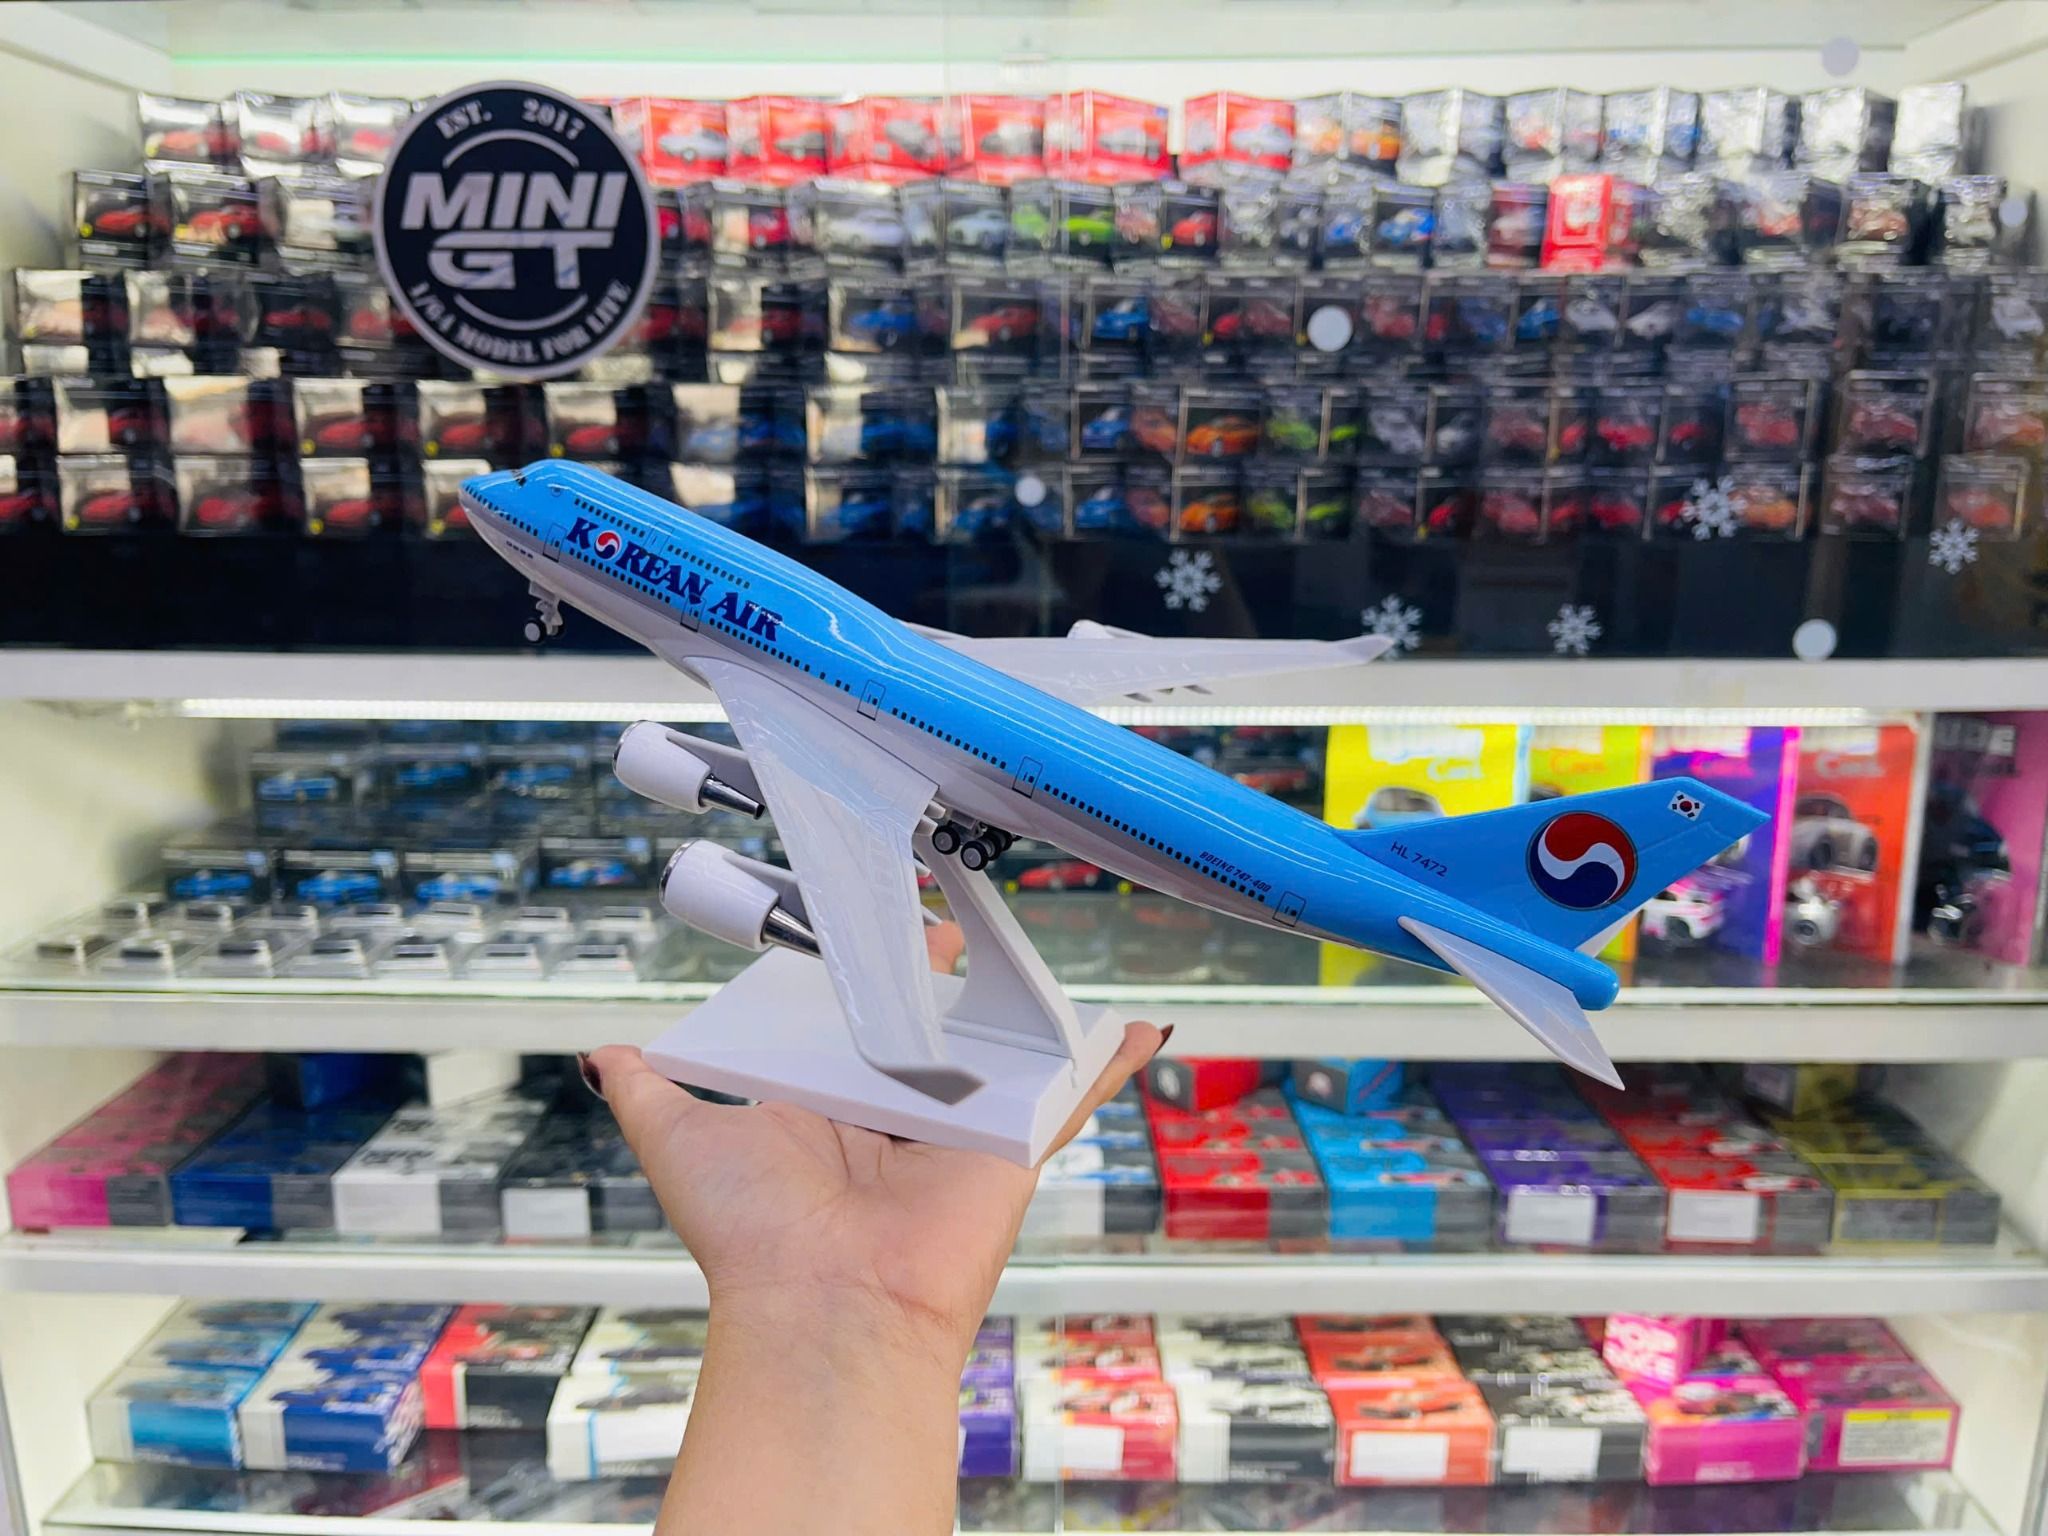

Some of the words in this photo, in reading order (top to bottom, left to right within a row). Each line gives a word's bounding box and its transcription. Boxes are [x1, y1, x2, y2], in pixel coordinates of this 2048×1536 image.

[436, 100, 492, 139] EST.
[522, 98, 585, 139] 2017
[401, 171, 628, 230] MINI
[427, 230, 614, 290] GT
[454, 322, 540, 363] MODEL
[540, 325, 591, 360] FOR
[585, 279, 631, 334] LIFE
[566, 517, 713, 604] KOREAN
[708, 591, 783, 642] AIR
[1199, 851, 1235, 873] BOEING
[1233, 869, 1272, 893] 747-400
[1390, 841, 1408, 860] HL
[1411, 852, 1448, 877] 7472
